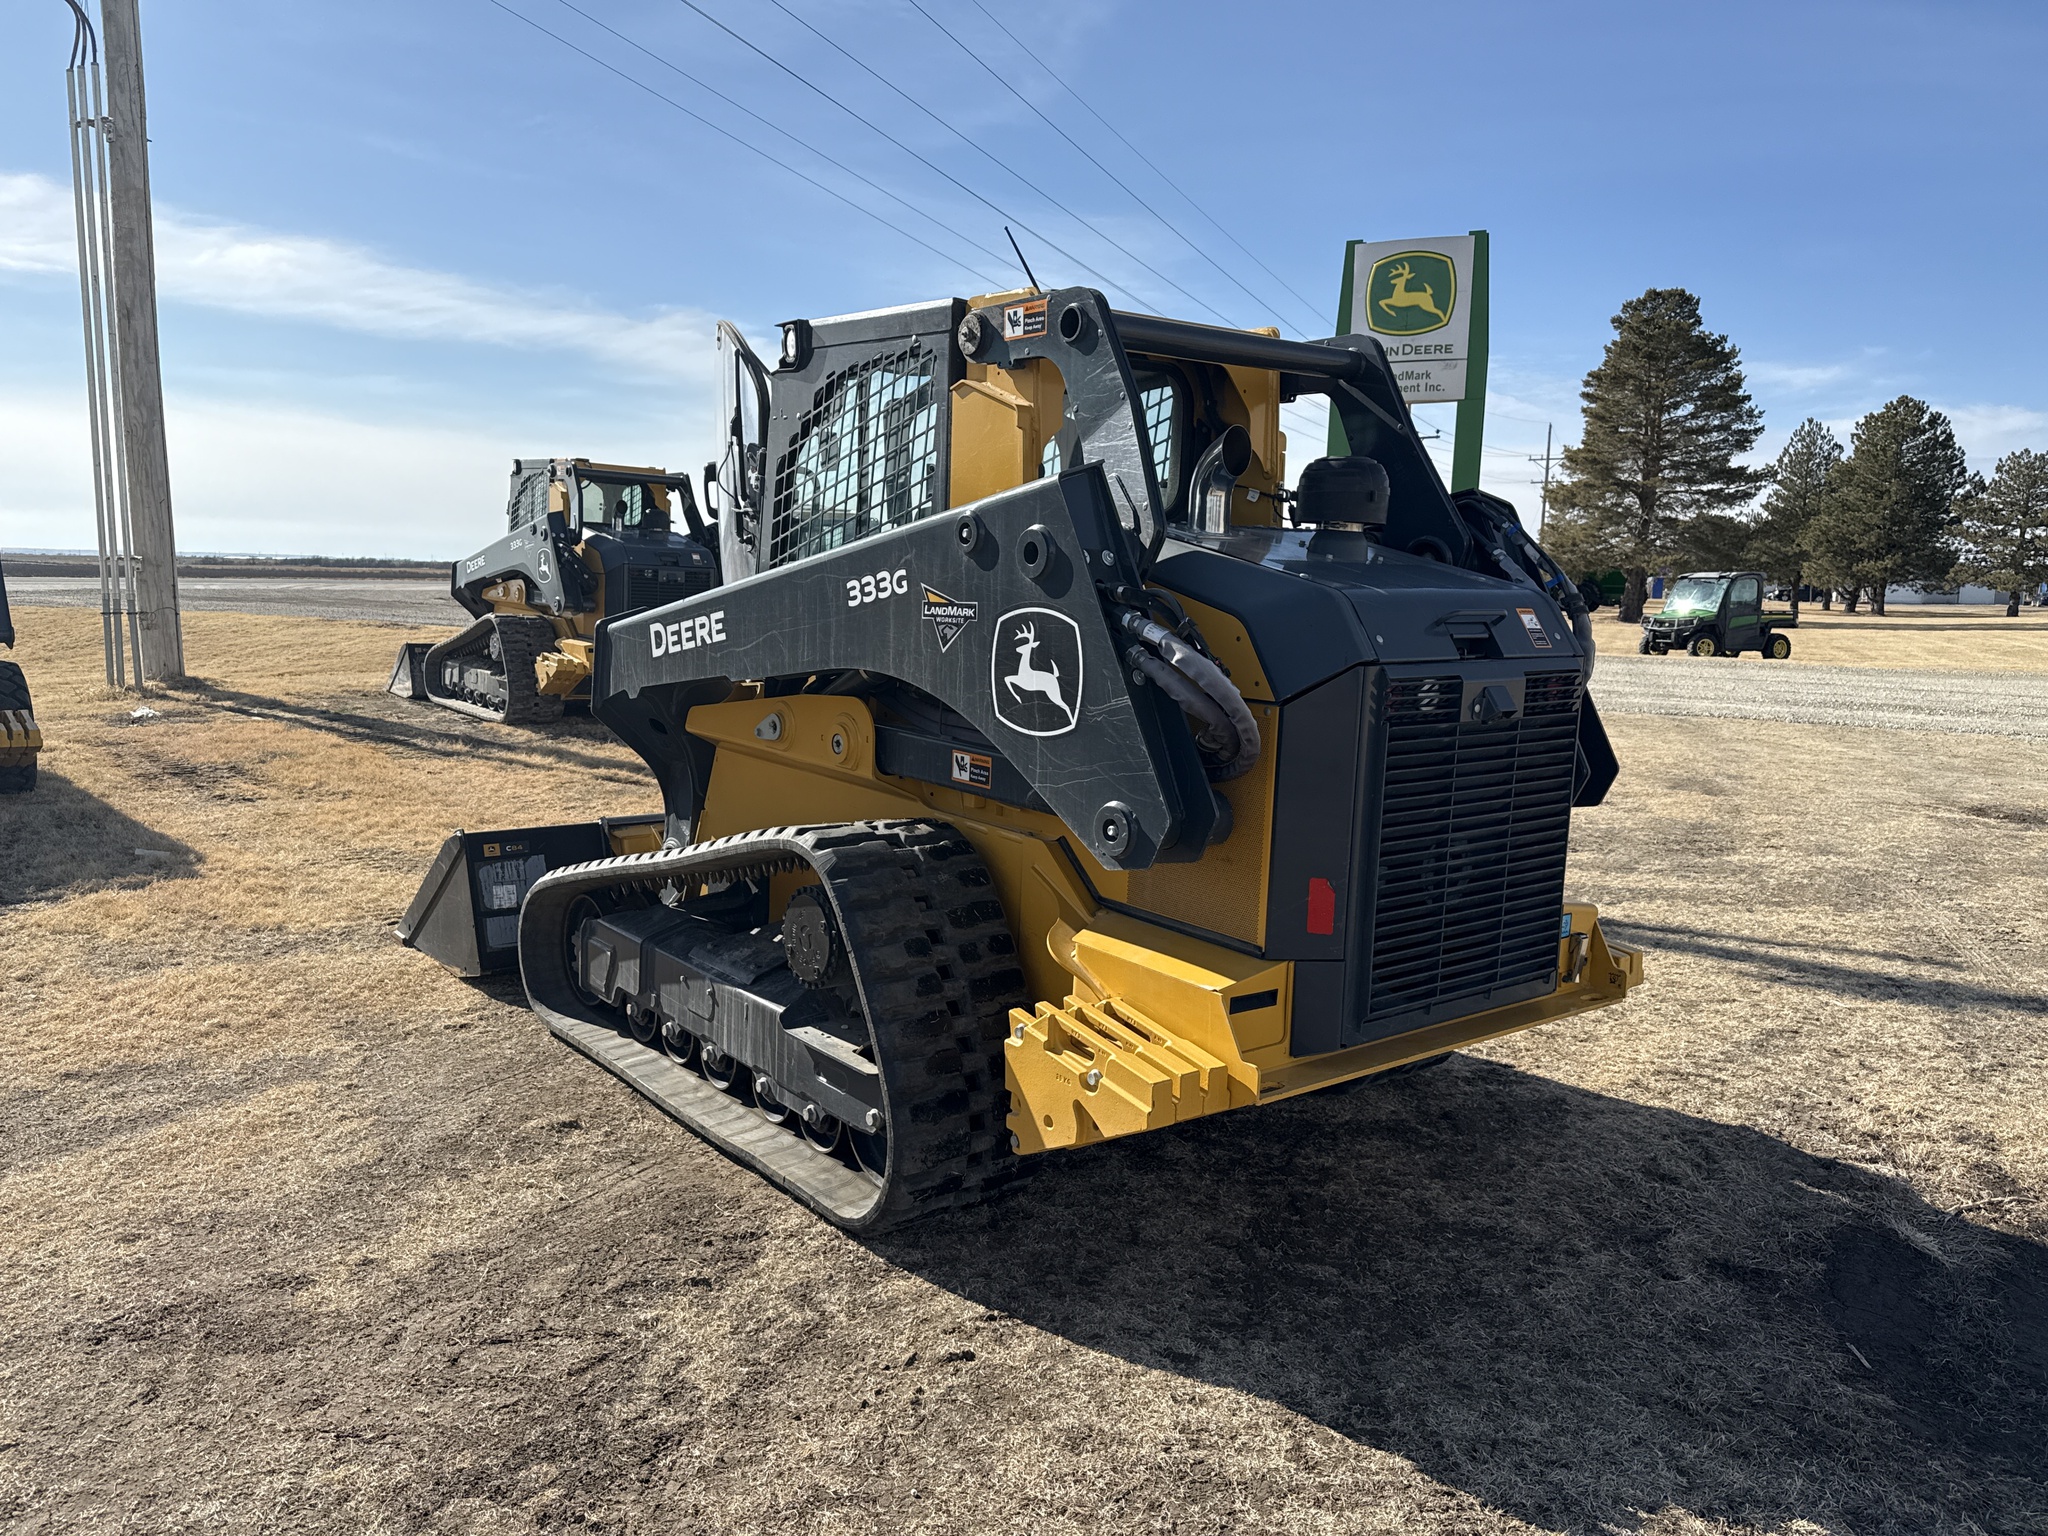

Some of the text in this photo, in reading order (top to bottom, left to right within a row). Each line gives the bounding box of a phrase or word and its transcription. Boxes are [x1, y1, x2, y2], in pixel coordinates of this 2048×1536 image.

[1402, 343, 1454, 356] DEERE
[1424, 382, 1446, 392] Inc.
[509, 538, 523, 551] 333G
[466, 554, 486, 574] DEERE
[846, 569, 908, 607] 333G
[924, 604, 975, 617] LANDMARK
[935, 616, 965, 624] WORKSITE
[649, 610, 727, 658] DEERE
